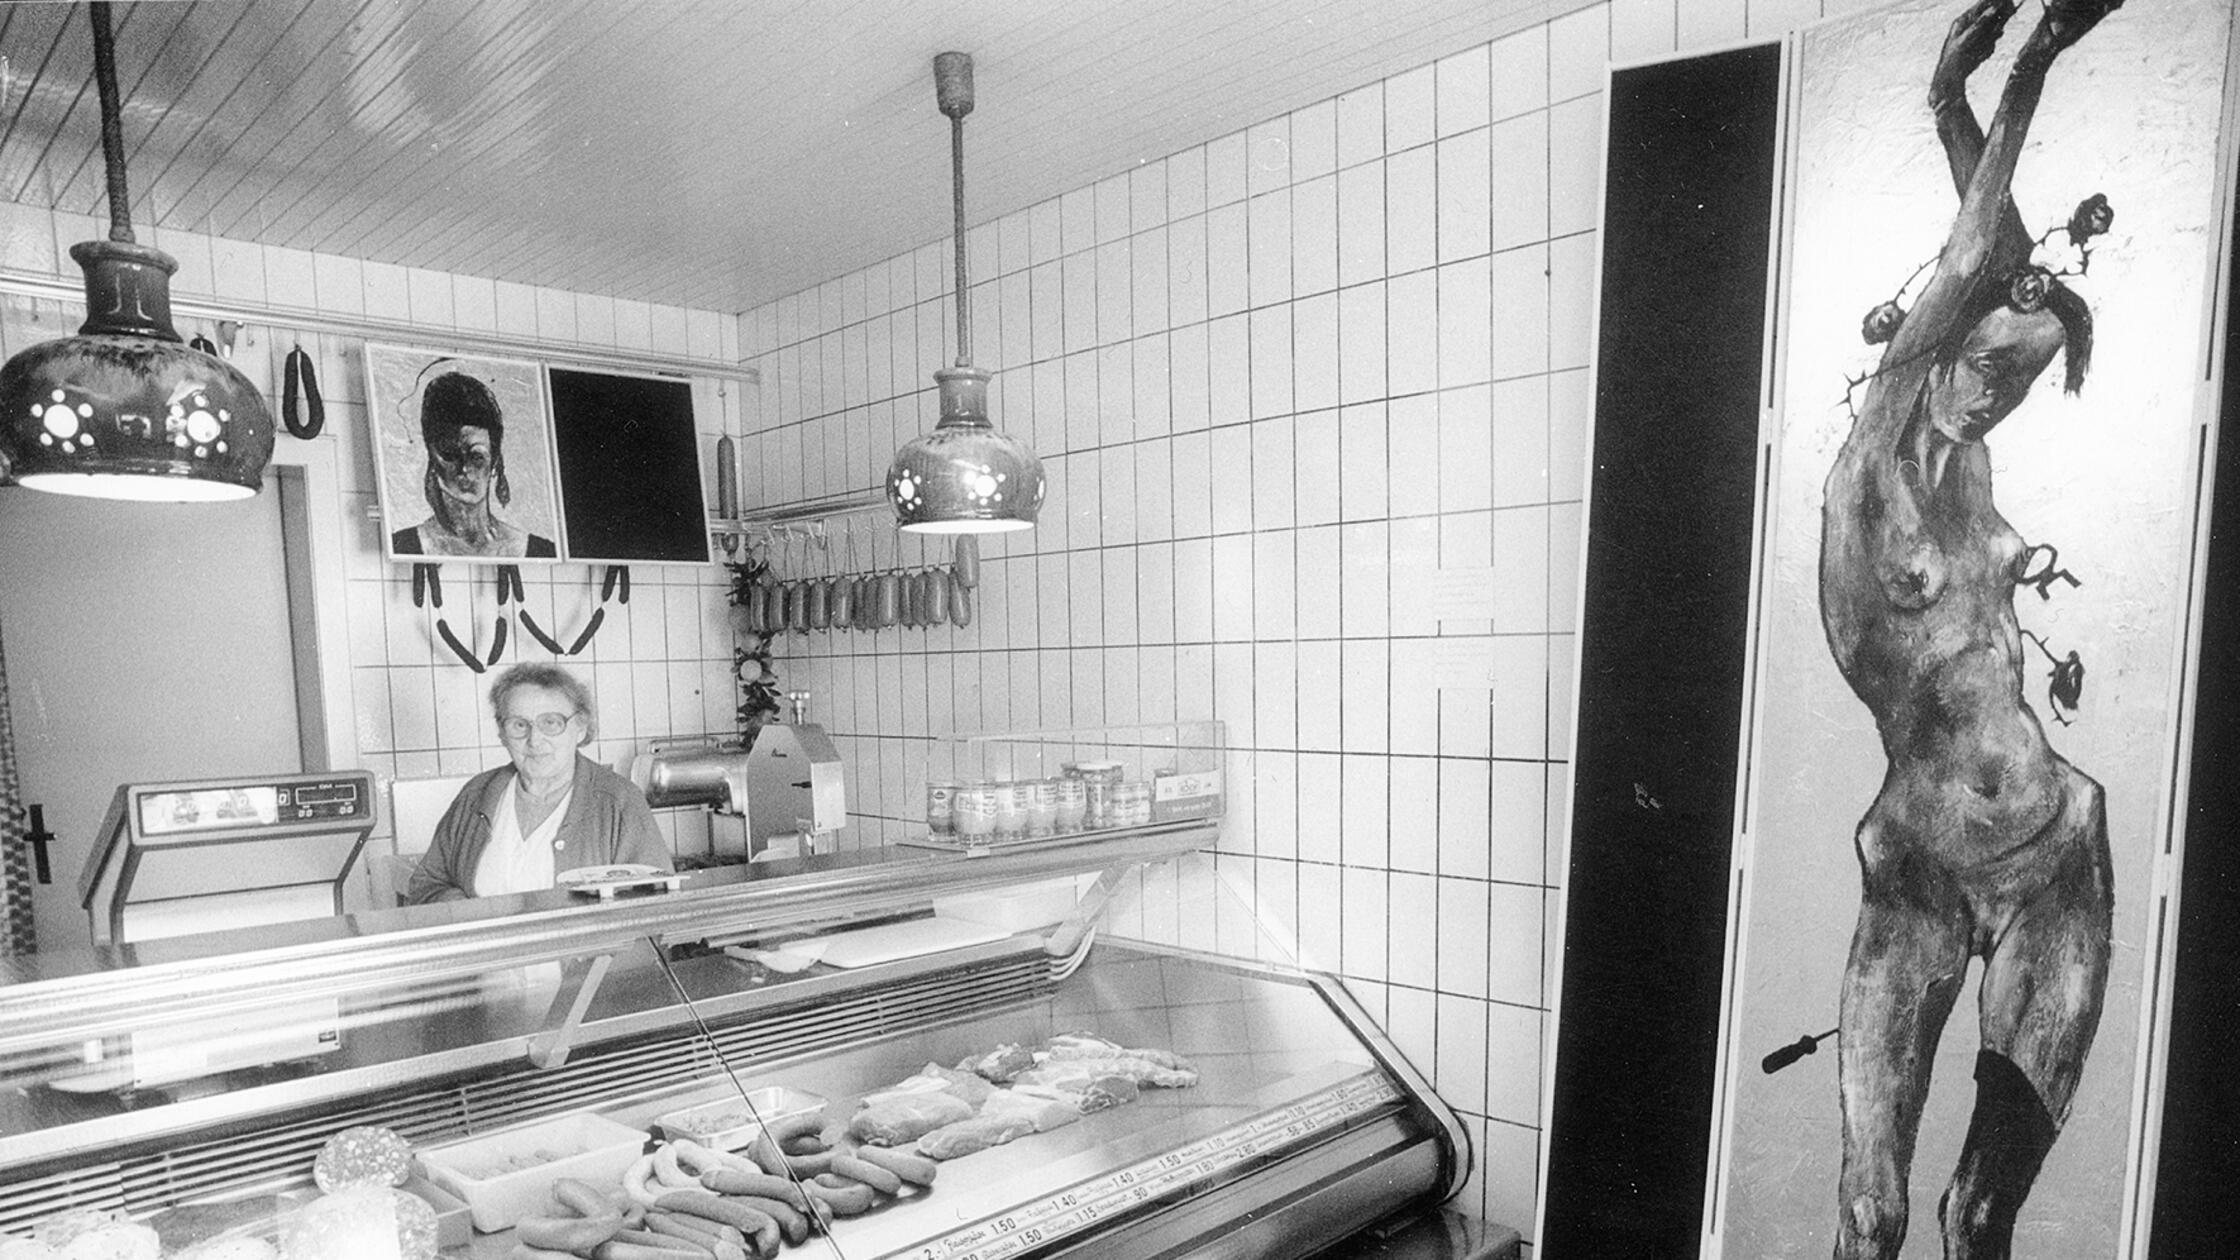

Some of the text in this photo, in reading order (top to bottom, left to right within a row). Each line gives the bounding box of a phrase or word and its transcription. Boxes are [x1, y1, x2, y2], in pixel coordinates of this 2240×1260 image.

[1159, 1153, 1182, 1170] 1.50
[1112, 1171, 1135, 1188] 1.40
[1052, 1193, 1078, 1211] 1.40
[1075, 1205, 1098, 1224] 1.15
[990, 1216, 1017, 1235] 1.50
[1018, 1228, 1043, 1247] 1.50
